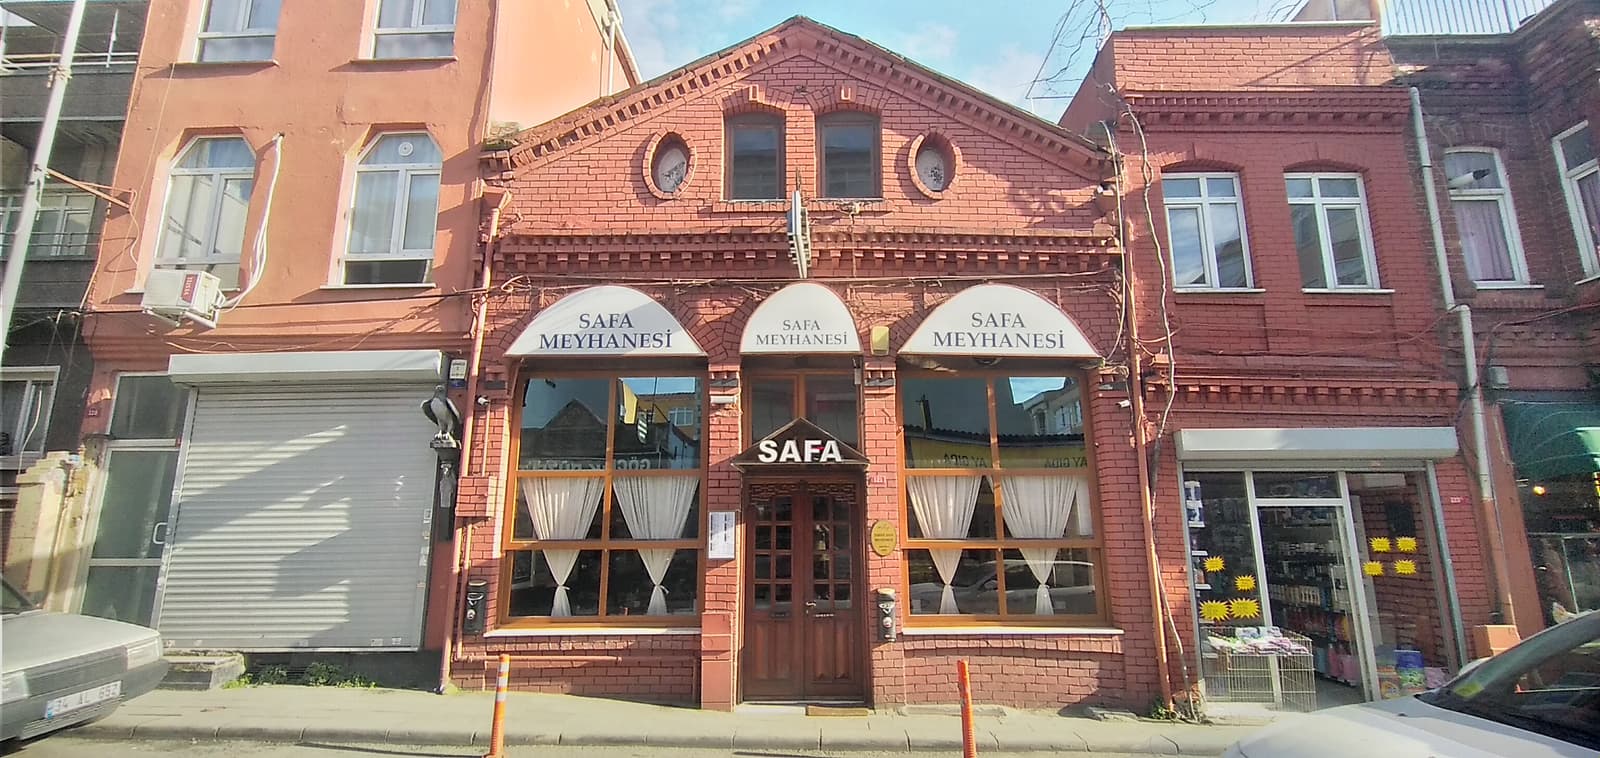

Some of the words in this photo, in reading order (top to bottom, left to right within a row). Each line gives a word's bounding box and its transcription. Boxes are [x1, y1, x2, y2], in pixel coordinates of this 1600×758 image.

[578, 312, 635, 329] SAFA
[782, 319, 821, 331] SAFA
[971, 312, 1026, 328] SAFA
[539, 329, 673, 350] MEYHANESİ
[756, 331, 848, 345] MEYHANESİ
[933, 329, 1065, 349] MEYHANESİ
[757, 439, 842, 463] SAFA
